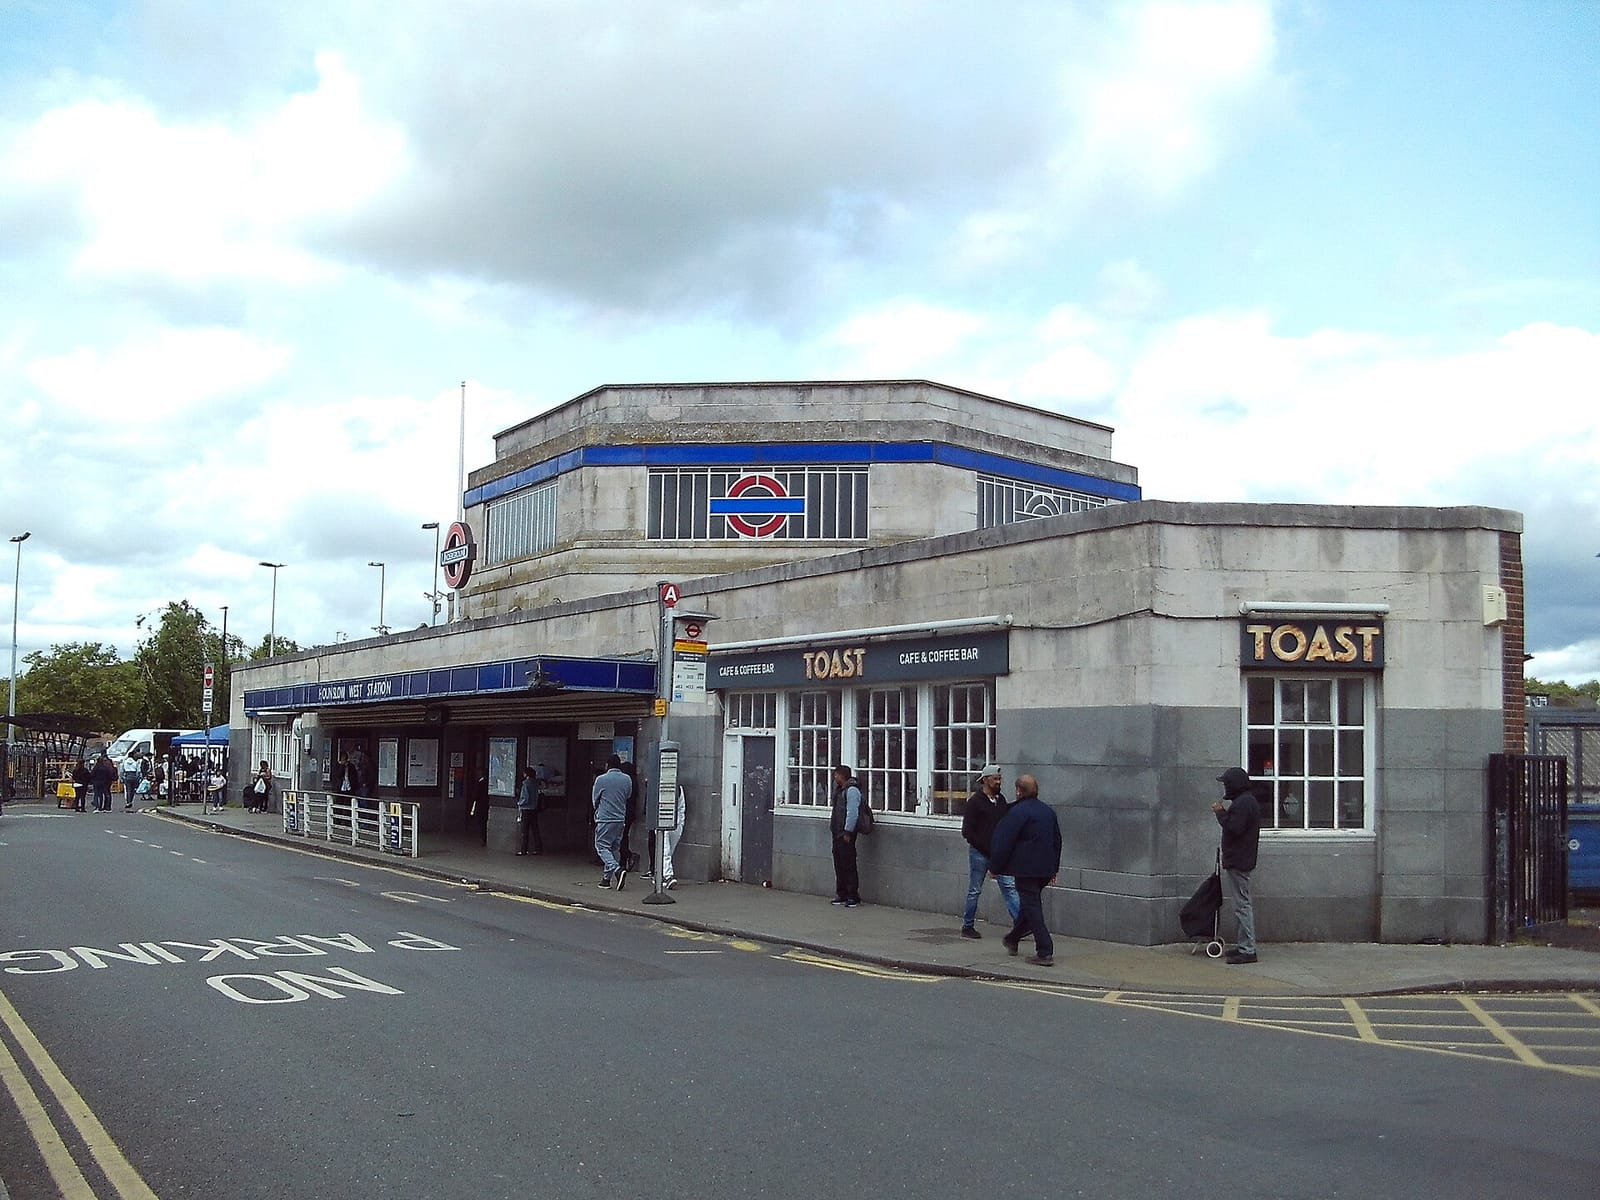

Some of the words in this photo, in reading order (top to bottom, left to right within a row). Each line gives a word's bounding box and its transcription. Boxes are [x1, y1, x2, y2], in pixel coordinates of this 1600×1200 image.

[664, 586, 677, 602] A
[1246, 624, 1380, 663] TOAST
[803, 648, 866, 680] TOAST
[899, 652, 920, 665] CAFE
[920, 651, 928, 663] &
[928, 649, 960, 663] COFFEE
[960, 647, 979, 661] BAR
[719, 665, 735, 677] CAFE
[734, 665, 740, 676] &
[739, 664, 762, 676] COFFEE
[762, 663, 775, 674] BAR
[348, 684, 363, 698] WEST
[366, 680, 392, 697] STATION
[206, 967, 405, 1004] NO
